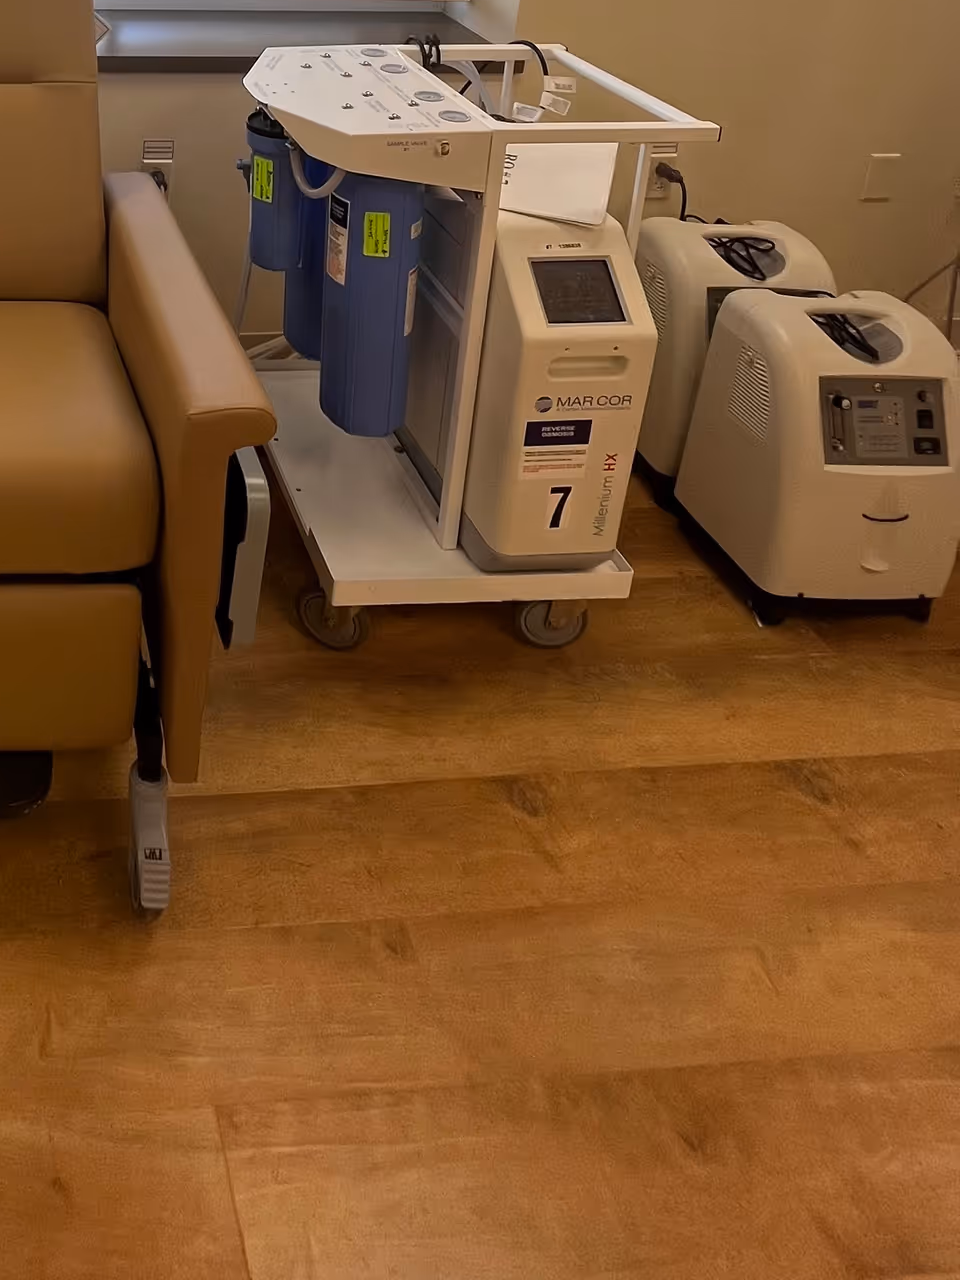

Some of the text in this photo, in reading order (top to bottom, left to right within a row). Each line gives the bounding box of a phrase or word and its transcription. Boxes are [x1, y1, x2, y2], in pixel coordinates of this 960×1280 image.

[556, 395, 633, 407] MAR COR
[603, 452, 618, 472] HX
[549, 486, 572, 528] 7
